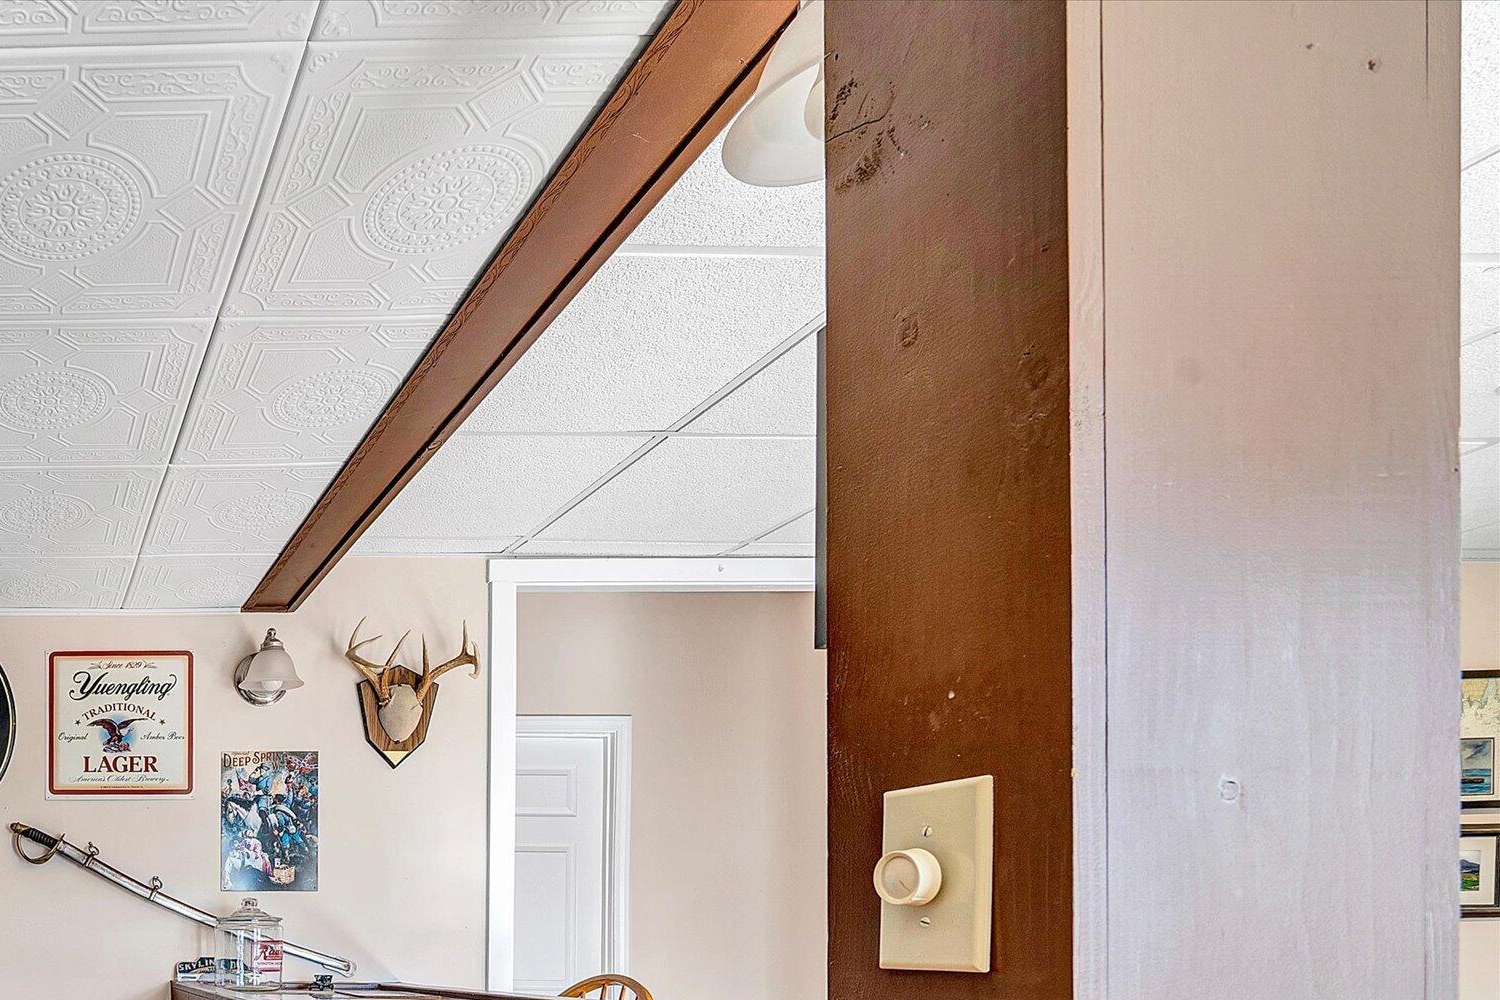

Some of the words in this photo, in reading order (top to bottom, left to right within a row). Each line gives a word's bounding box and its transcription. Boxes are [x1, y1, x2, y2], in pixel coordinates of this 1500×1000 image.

[69, 671, 178, 700] Yuengling
[82, 702, 157, 721] TRADITIONAL
[58, 732, 89, 743] Original
[140, 731, 165, 740] Amber
[83, 756, 158, 773] LAGER
[223, 753, 251, 767] DEEP
